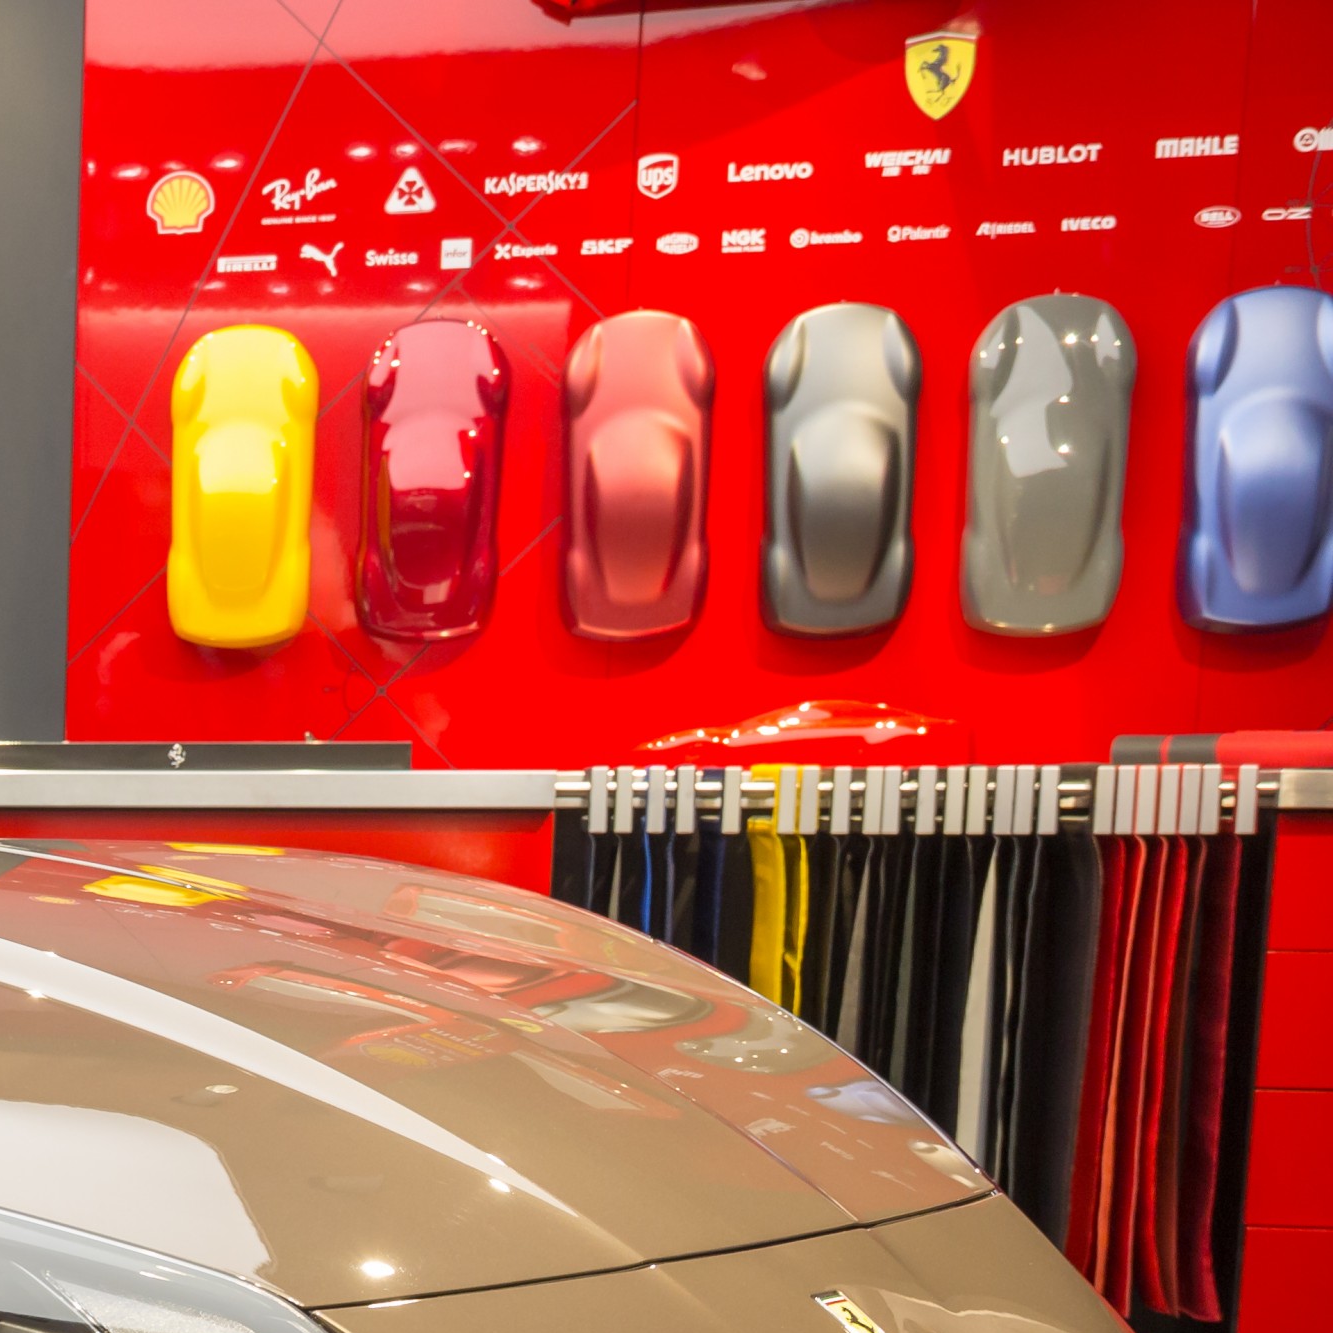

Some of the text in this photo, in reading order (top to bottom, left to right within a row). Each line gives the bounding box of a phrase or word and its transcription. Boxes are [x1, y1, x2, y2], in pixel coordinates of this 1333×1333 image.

[1002, 143, 1102, 167] HUBLOT
[1155, 134, 1239, 159] MAHLE
[727, 161, 813, 182] Lenovo
[262, 168, 337, 210] Ray-Ban
[1060, 216, 1117, 232] IVECO
[721, 228, 766, 247] NGK
[809, 229, 862, 244] brembo
[580, 237, 633, 256] SKF
[365, 248, 419, 267] Swisse
